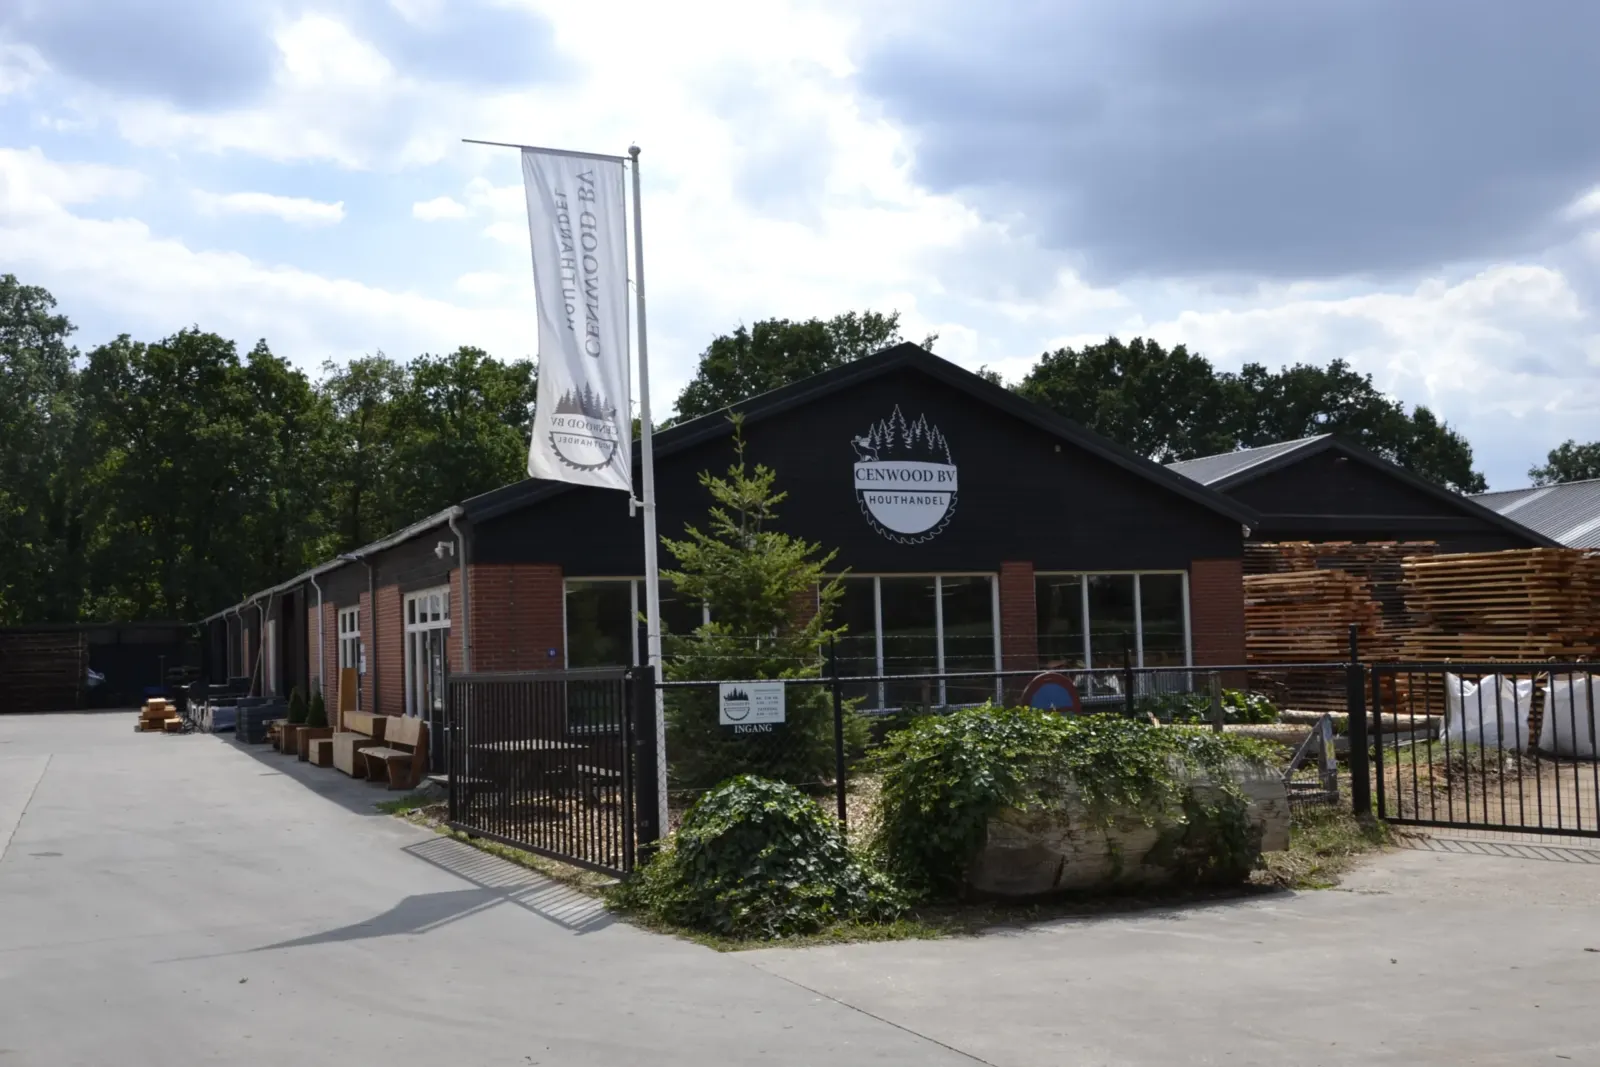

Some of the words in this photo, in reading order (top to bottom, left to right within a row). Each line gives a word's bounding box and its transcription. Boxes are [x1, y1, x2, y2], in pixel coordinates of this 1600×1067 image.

[855, 468, 934, 482] CENWOOD
[937, 470, 956, 482] BV
[869, 495, 945, 506] HOUTHANDEL
[734, 723, 772, 733] INGANG
